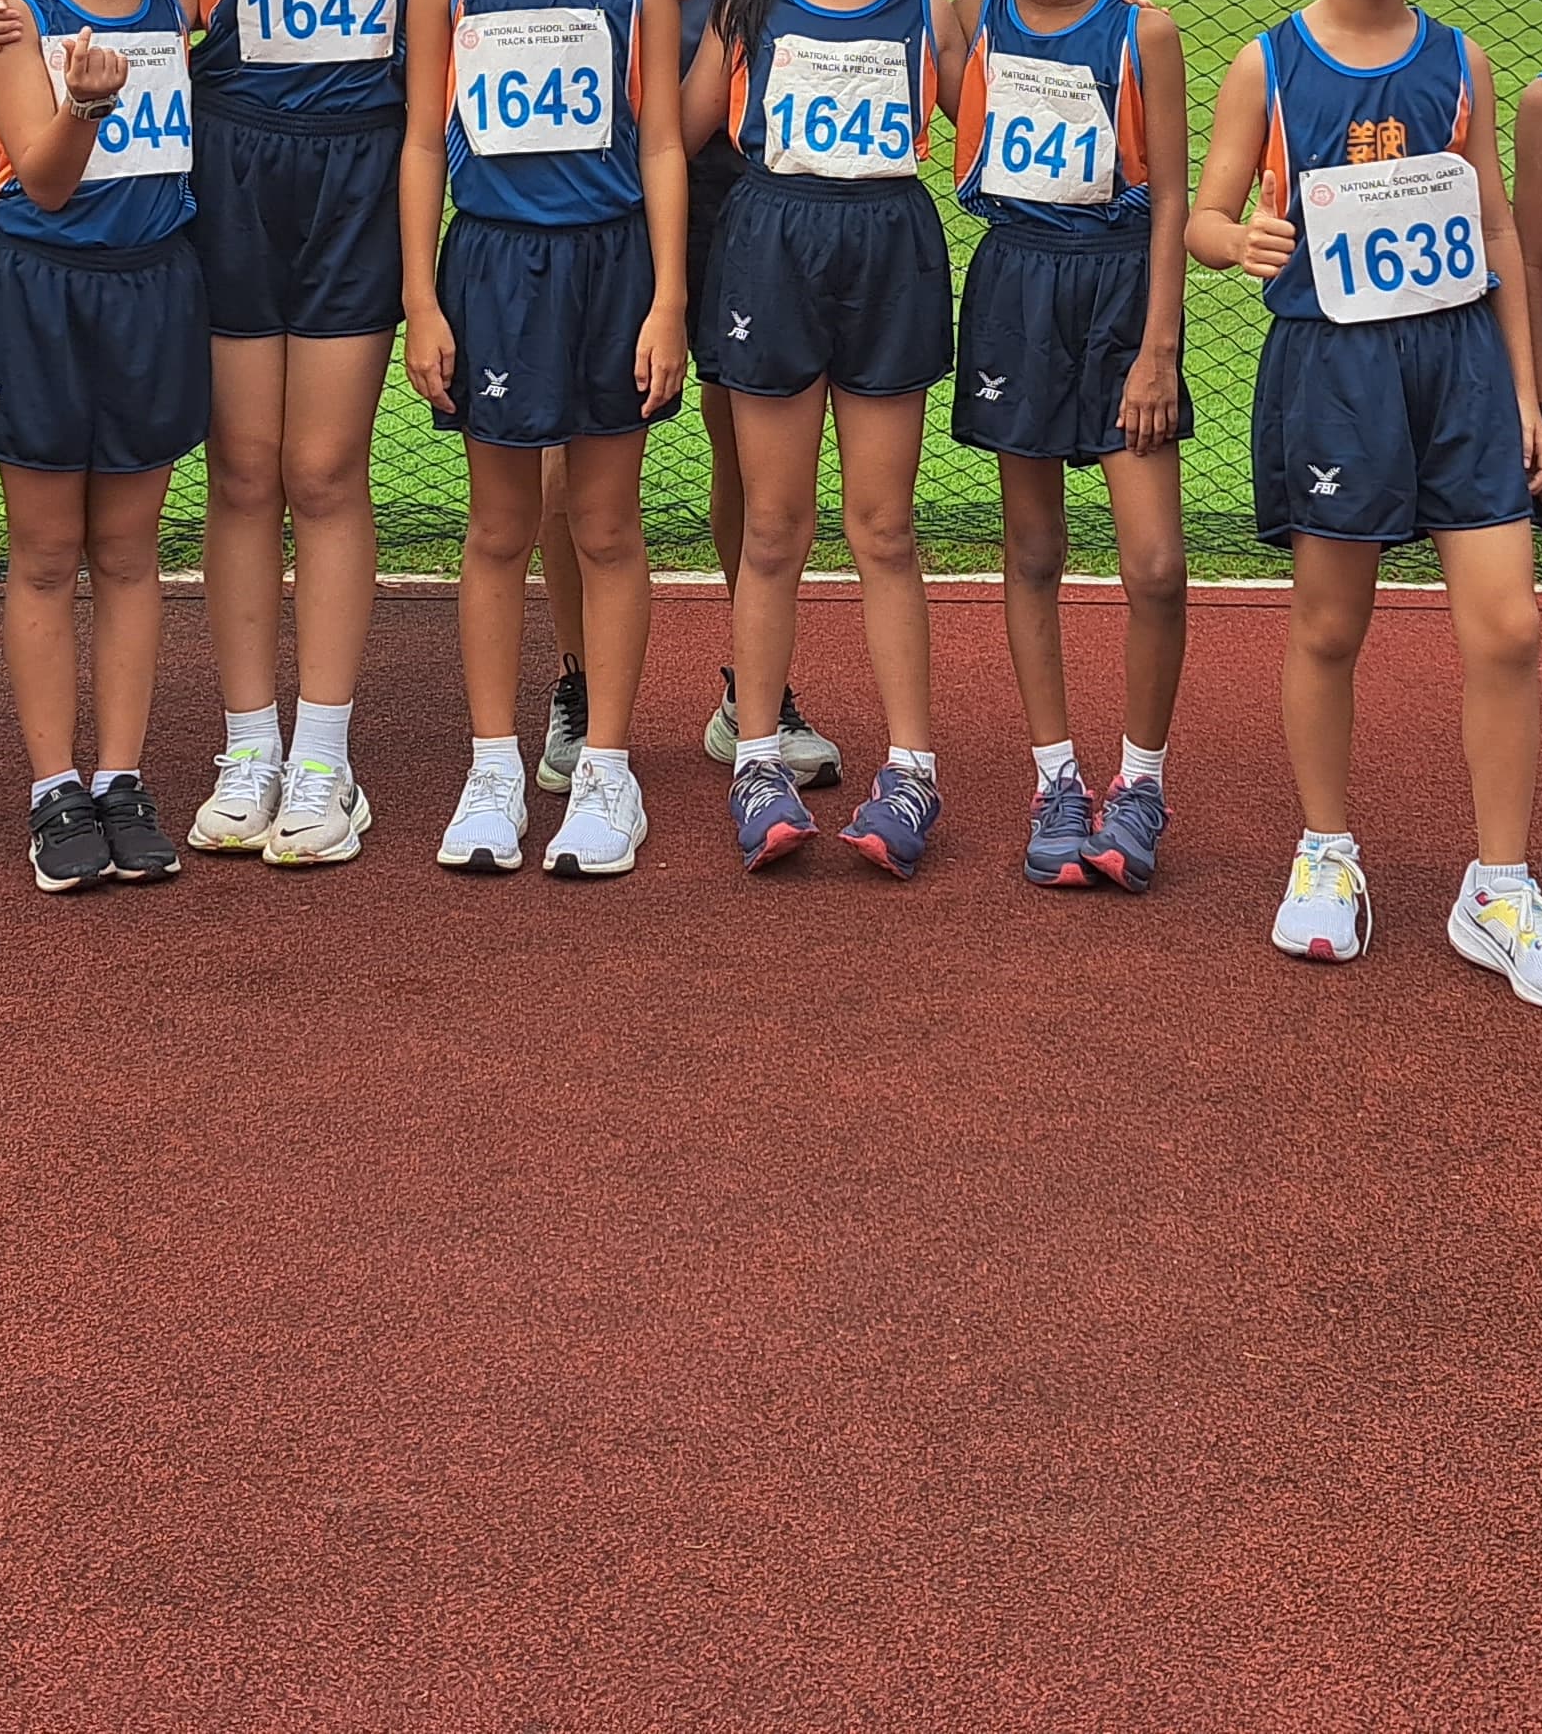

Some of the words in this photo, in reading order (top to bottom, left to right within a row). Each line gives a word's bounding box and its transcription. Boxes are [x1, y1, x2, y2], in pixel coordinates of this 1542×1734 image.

[484, 26, 524, 37] NATIONAL
[528, 24, 565, 34] SCHOOL
[568, 23, 598, 32] GAMES
[497, 37, 526, 46] TRACK
[527, 37, 533, 45] &
[535, 36, 560, 45] FIELD
[561, 34, 584, 43] MEET
[151, 46, 176, 55] GAMES
[797, 50, 840, 62] NATIONAL
[843, 52, 879, 64] SCHOOL
[147, 58, 166, 66] MEET
[812, 62, 842, 72] TRACK
[842, 64, 848, 72] &
[849, 65, 874, 75] FIELD
[875, 67, 897, 77] MEET
[1001, 70, 1040, 82] NATIONAL
[1044, 76, 1073, 89] SCHOOL
[467, 66, 602, 131] 1643
[1014, 82, 1041, 94] TRACK
[1041, 87, 1047, 95] &
[1048, 88, 1068, 99] FIELD
[1069, 91, 1092, 101] MEET
[97, 89, 191, 154] 644
[771, 93, 910, 160] 1645
[982, 111, 1098, 183] 1641
[1340, 179, 1389, 193] NATIONAL
[1392, 174, 1432, 186] SCHOOL
[1435, 166, 1464, 179] GAMES
[1359, 191, 1393, 203] TRACK
[1393, 190, 1400, 198] &
[1401, 185, 1428, 198] FIELD
[1430, 181, 1453, 193] MEET
[1324, 215, 1474, 296] 1638
